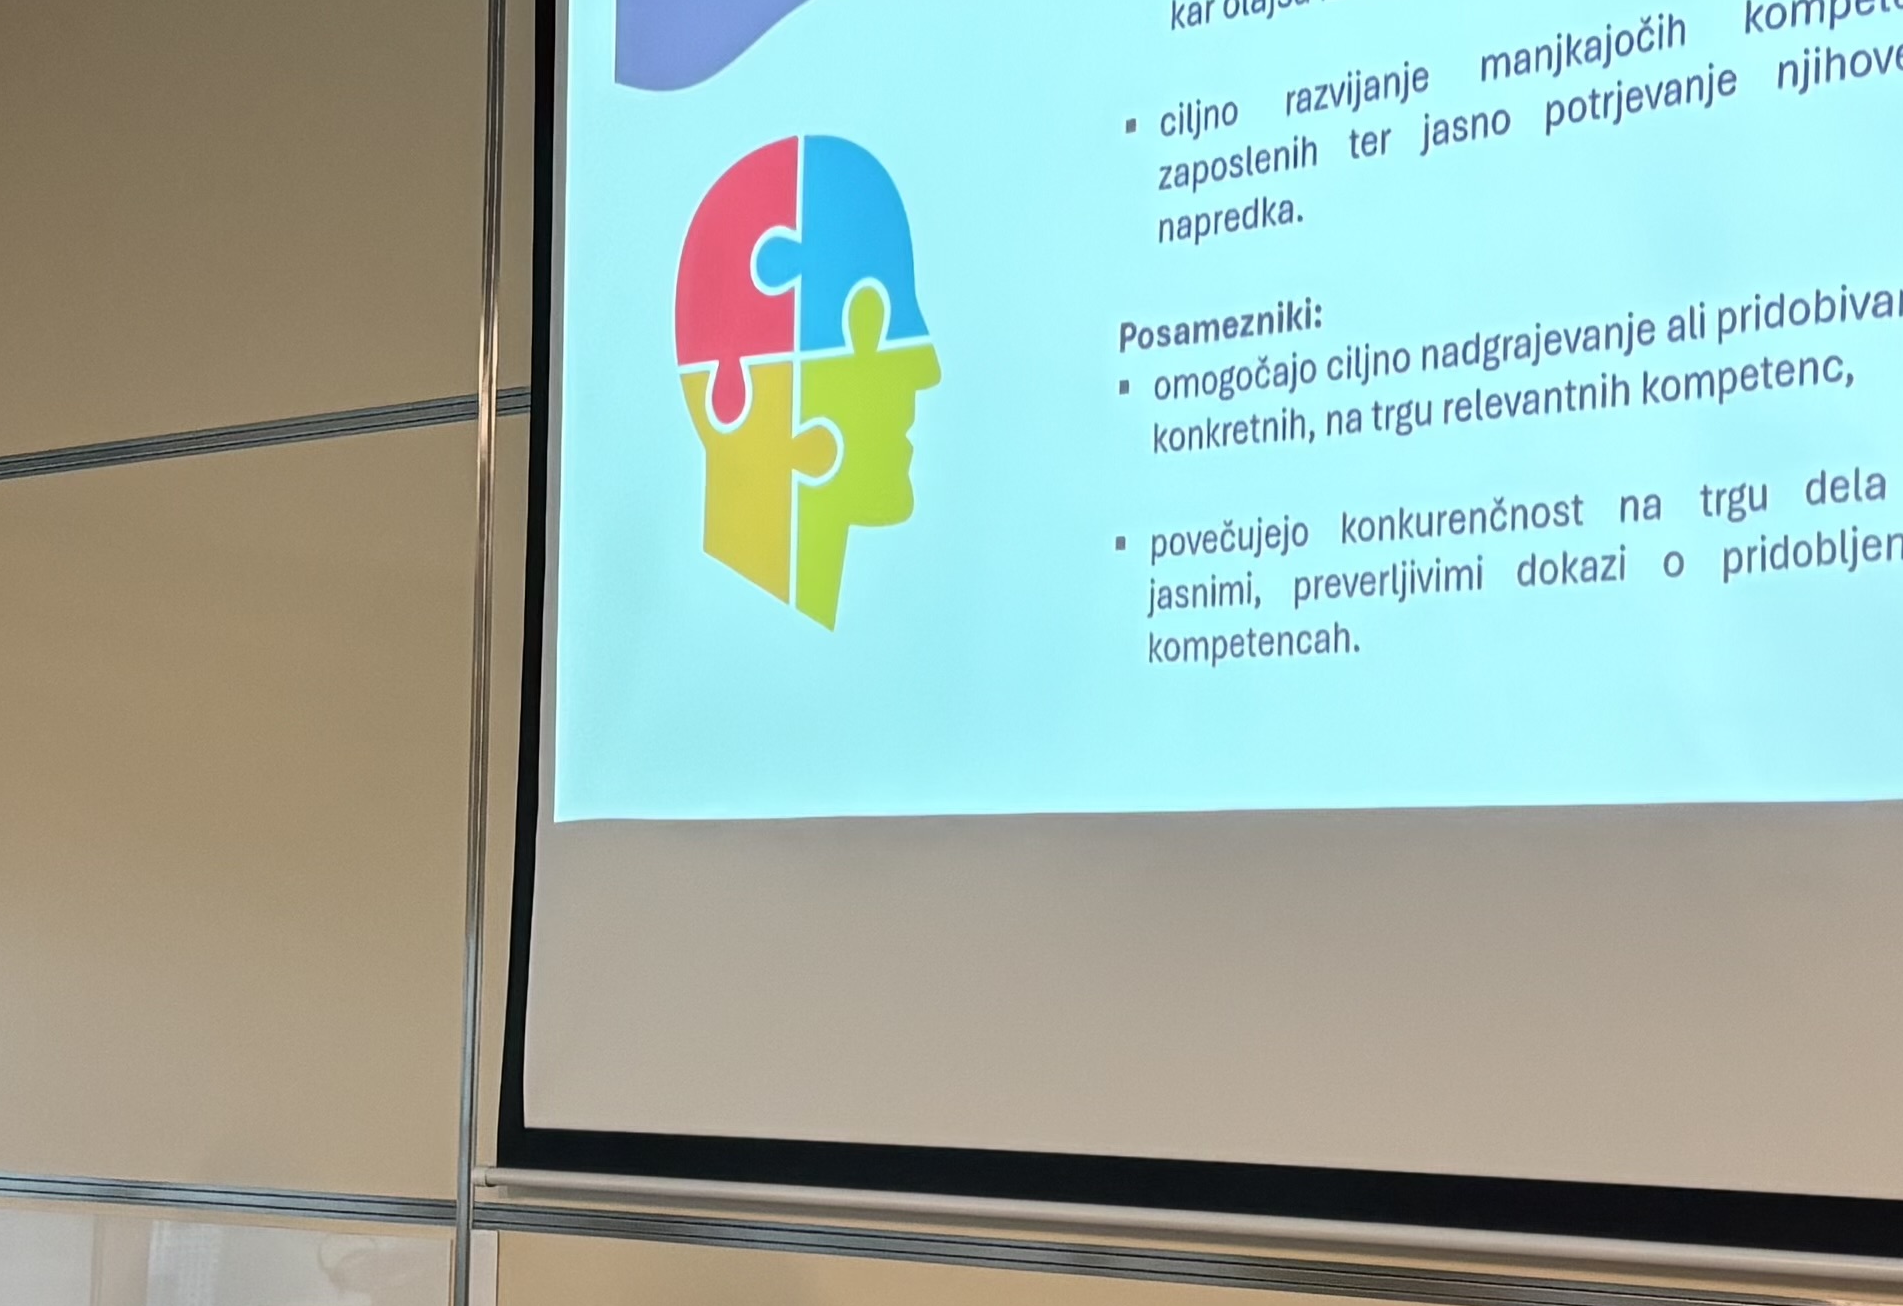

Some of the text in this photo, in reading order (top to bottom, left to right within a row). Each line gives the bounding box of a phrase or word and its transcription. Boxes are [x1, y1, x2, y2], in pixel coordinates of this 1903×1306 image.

[1161, 99, 1238, 140] ciljno
[1286, 61, 1429, 116] razvijanje
[1481, 14, 1685, 81] manjkajočih
[1159, 135, 1317, 193] zaposlenih
[1350, 129, 1391, 159] ter
[1420, 109, 1510, 156] jasno
[1546, 63, 1737, 136] potrjevanje
[1159, 196, 1303, 245] napredka.
[1120, 297, 1321, 353] Posamezniki:
[1155, 352, 1317, 401] omogočajo
[1327, 343, 1410, 385] ciljno
[1422, 312, 1655, 371] nadgrajevanje
[1667, 302, 1705, 342] ali
[1154, 355, 1853, 453] konkretnih, na trgu relevantnih kompetenc,
[1151, 515, 1308, 566] povečujejo
[1342, 495, 1583, 544] konkurenčnost
[1620, 494, 1661, 522] na
[1700, 483, 1767, 522] trgu
[1806, 467, 1886, 505] dela
[1147, 571, 1261, 618] jasnimi,
[1295, 555, 1482, 609] preverljivimi
[1517, 544, 1625, 586] dokazi
[1663, 551, 1684, 577] o
[1149, 622, 1359, 667] kompetencah.
